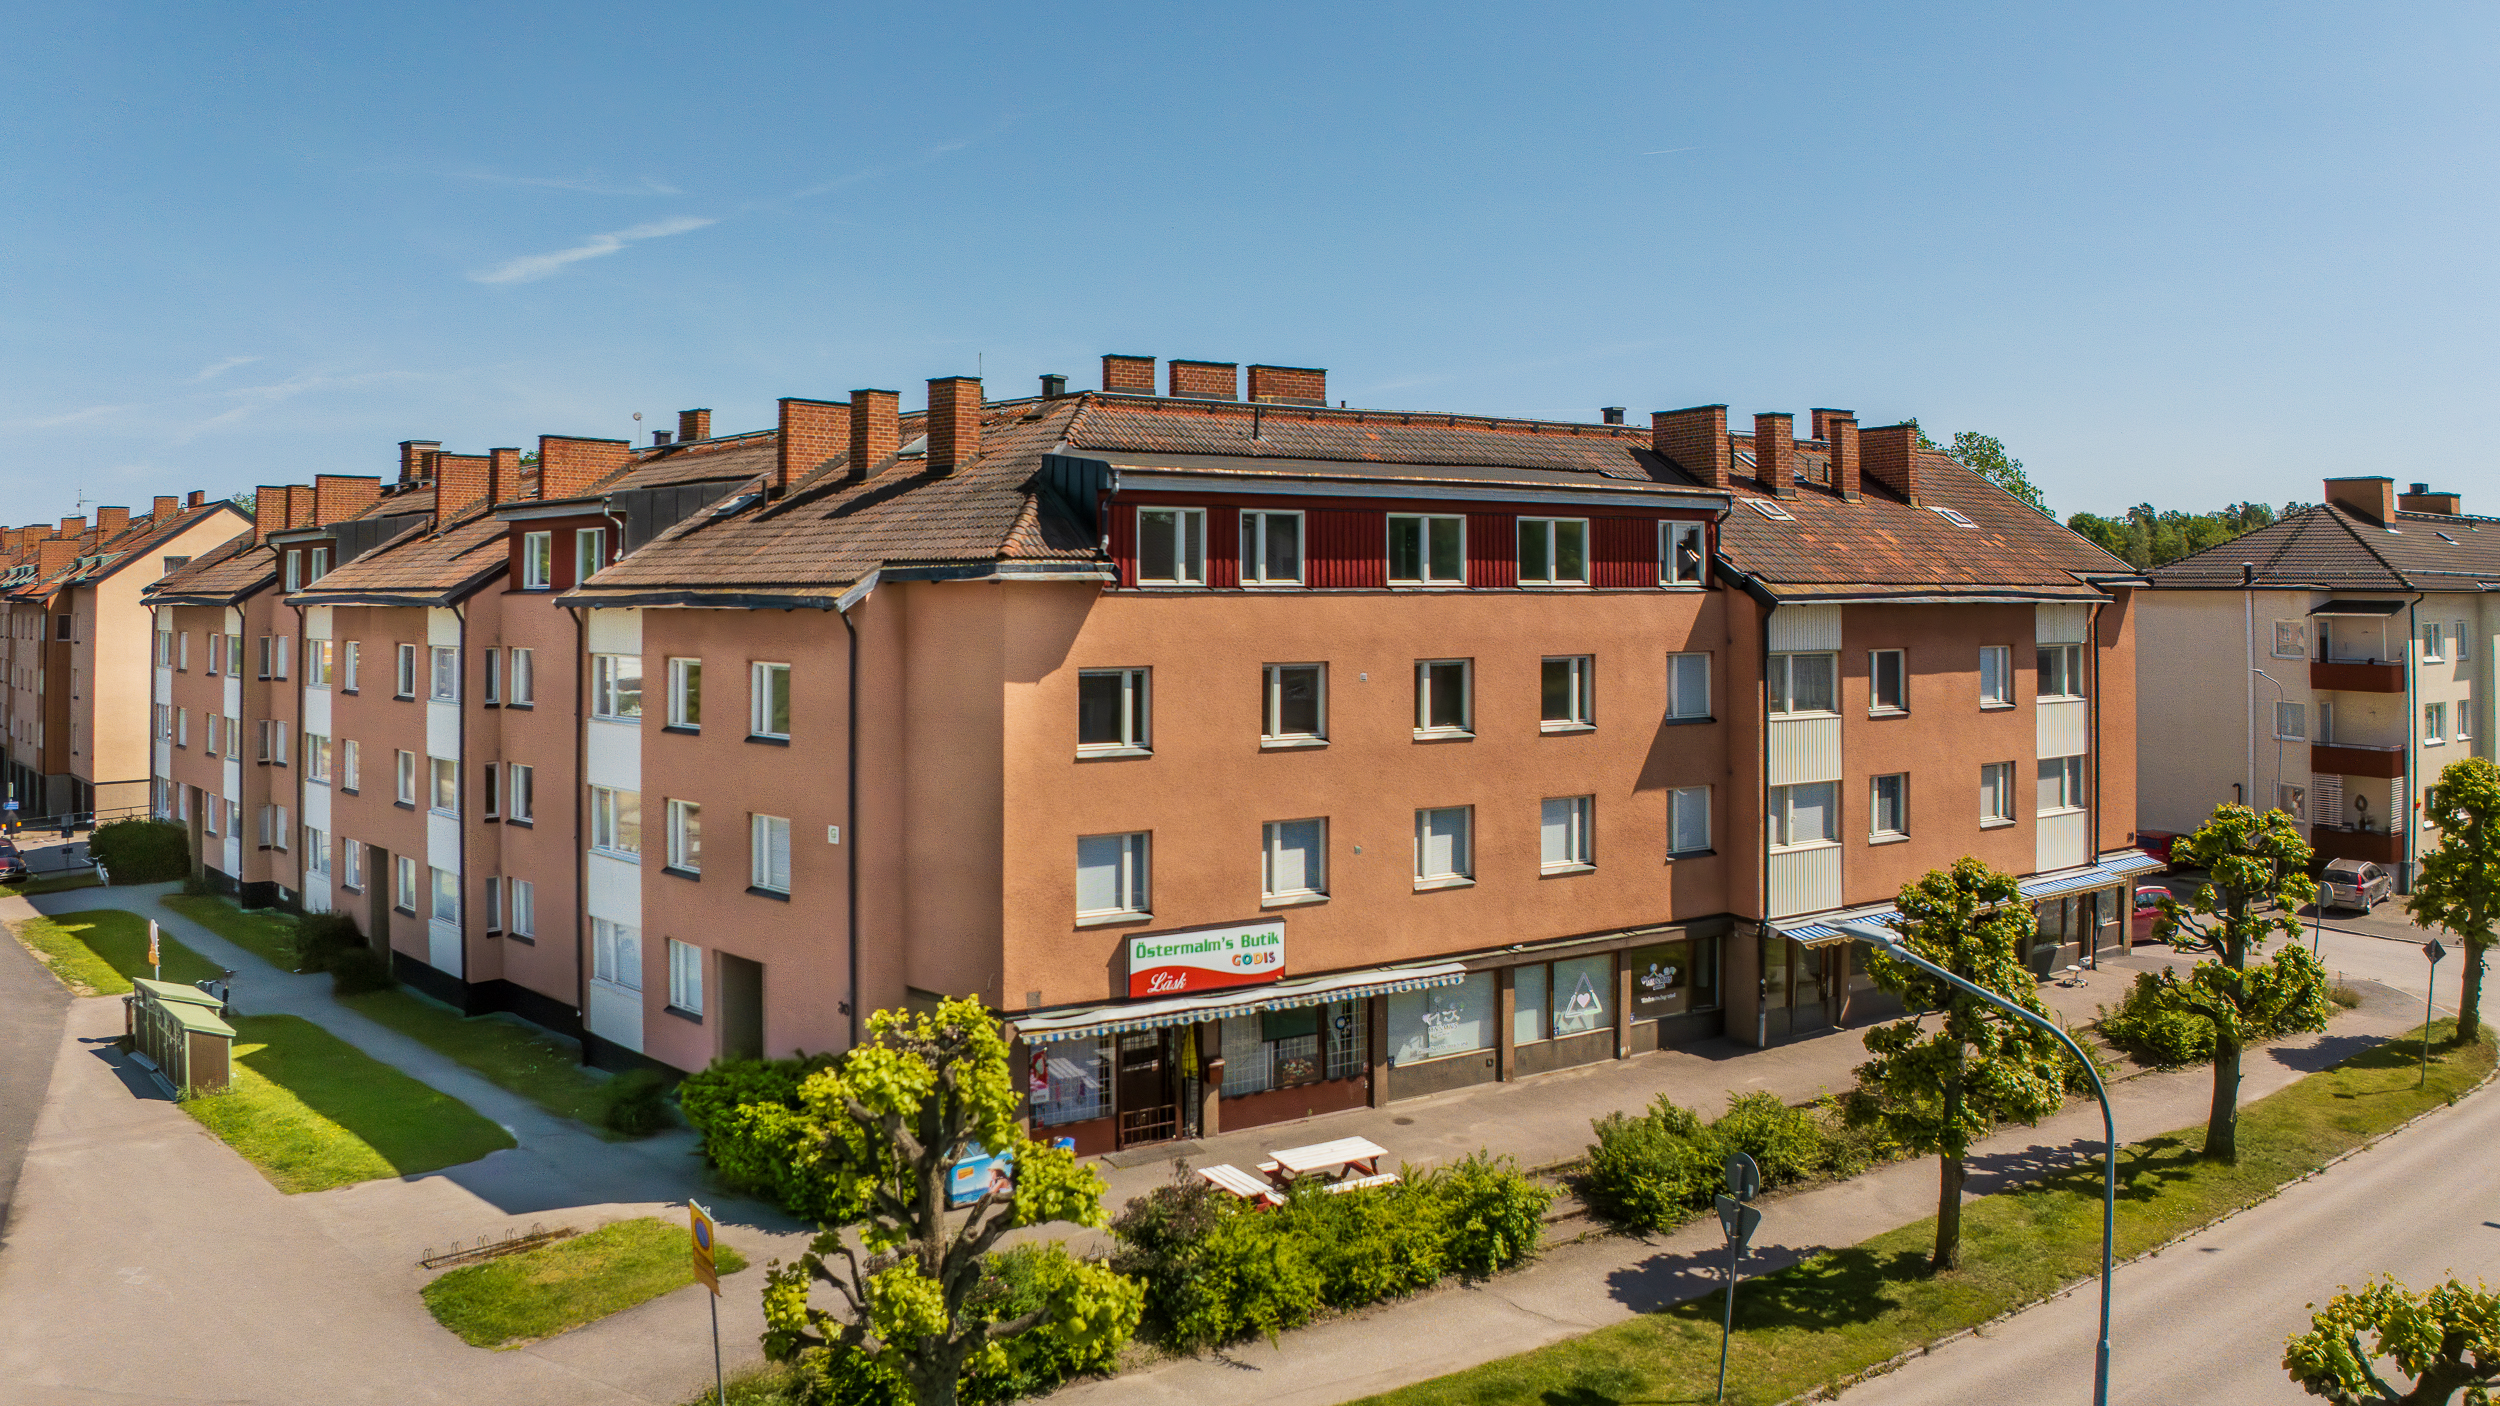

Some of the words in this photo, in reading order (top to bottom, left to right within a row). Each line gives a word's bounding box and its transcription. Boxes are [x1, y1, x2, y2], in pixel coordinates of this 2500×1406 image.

[1136, 936, 1234, 959] Östermalm's
[1241, 931, 1280, 949] Butik
[1232, 951, 1276, 967] GODIS
[1147, 972, 1187, 994] Läsk
